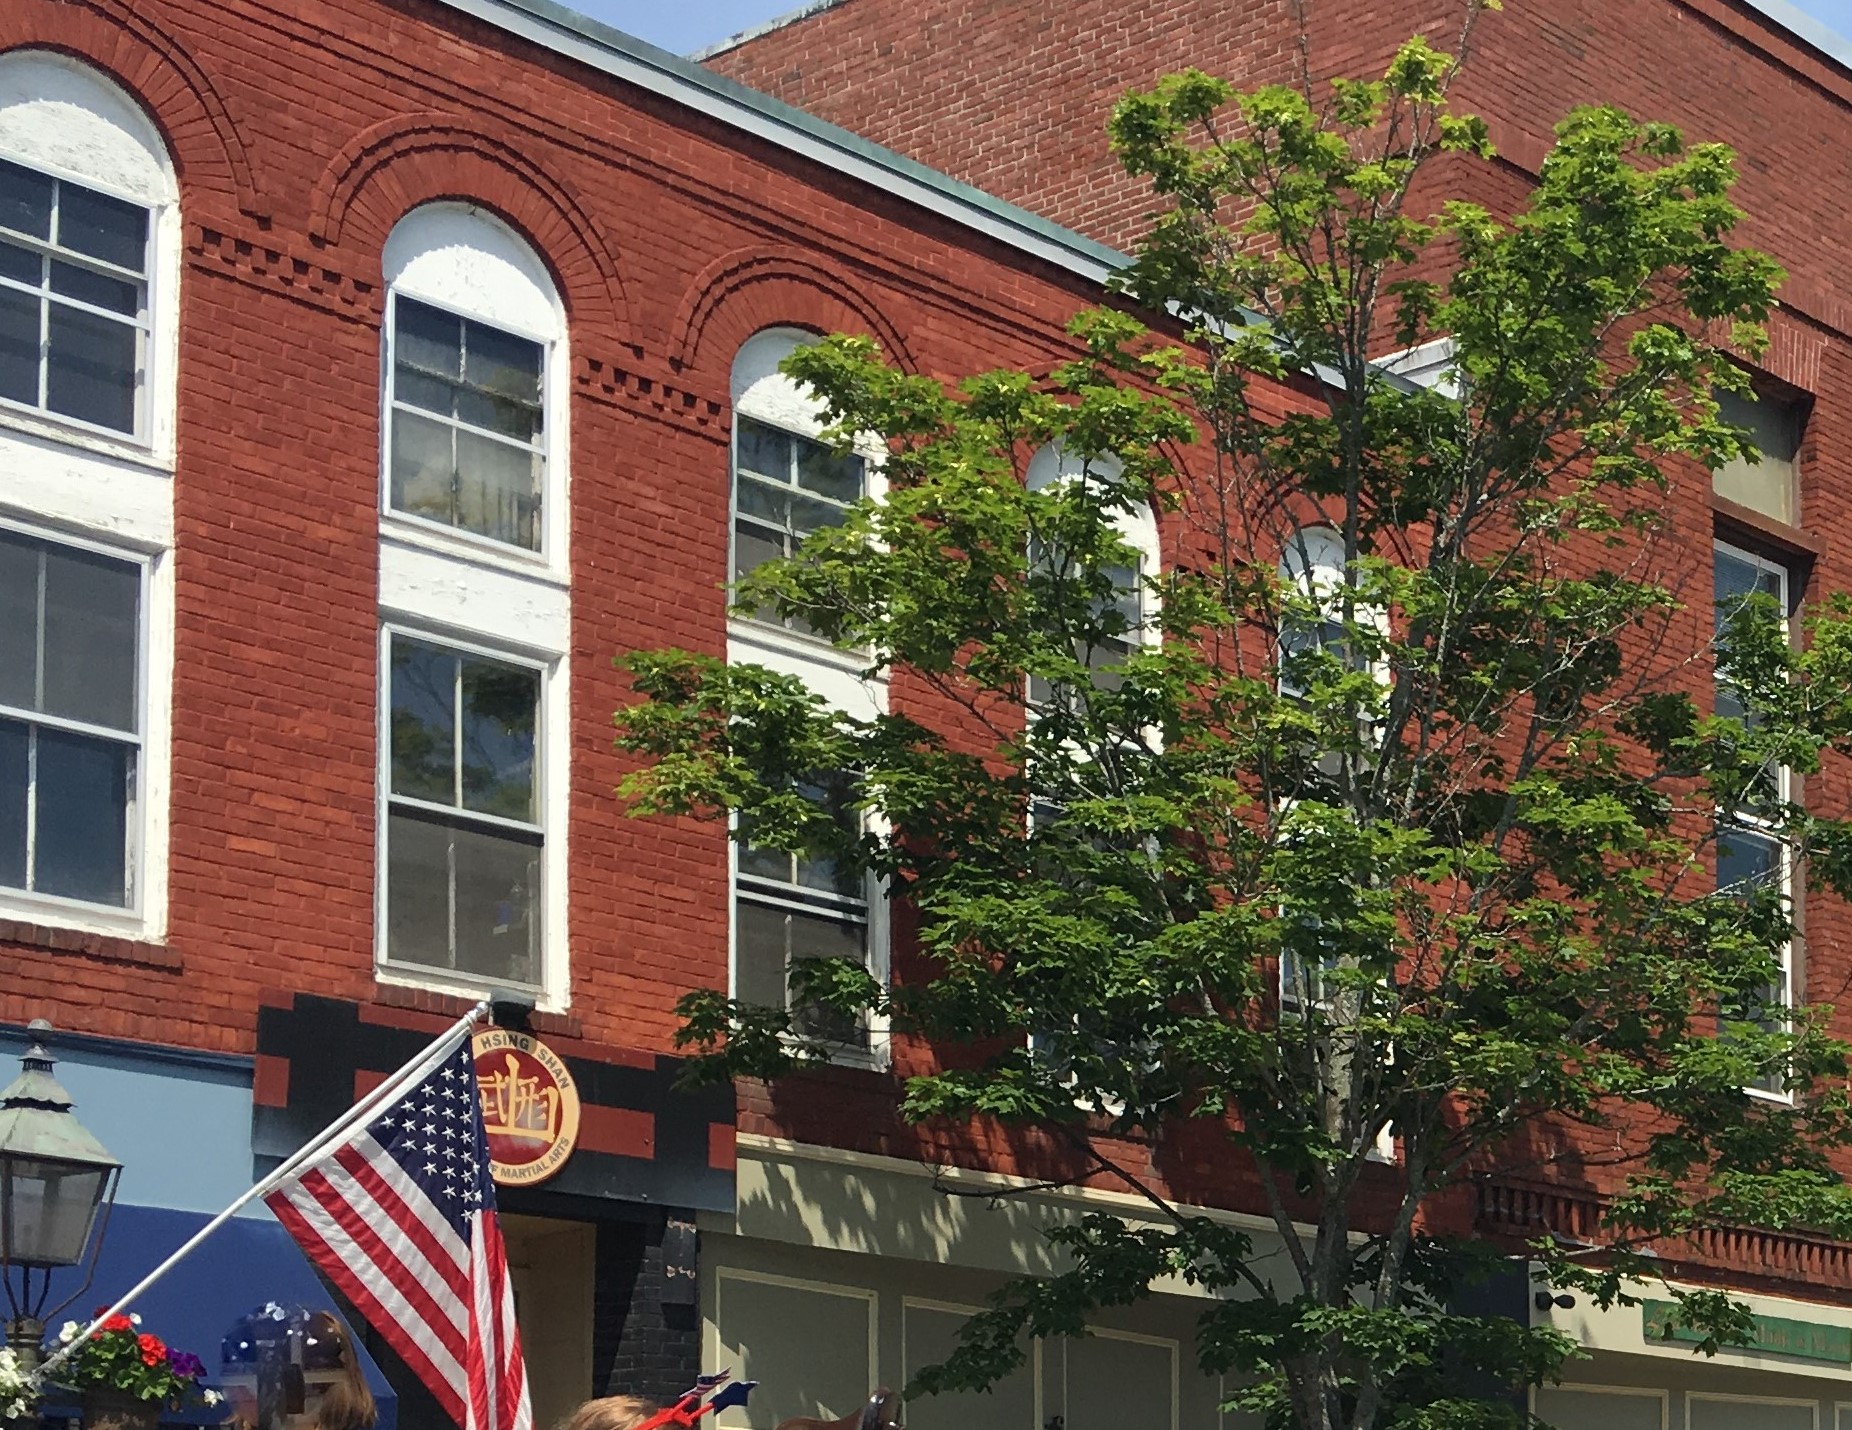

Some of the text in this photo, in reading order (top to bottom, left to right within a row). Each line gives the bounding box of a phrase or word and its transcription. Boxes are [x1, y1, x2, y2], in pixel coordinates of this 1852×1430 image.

[480, 1034, 571, 1090] HSING SHAN
[500, 1160, 551, 1179] MARTIAL
[549, 1137, 570, 1165] ARTS
